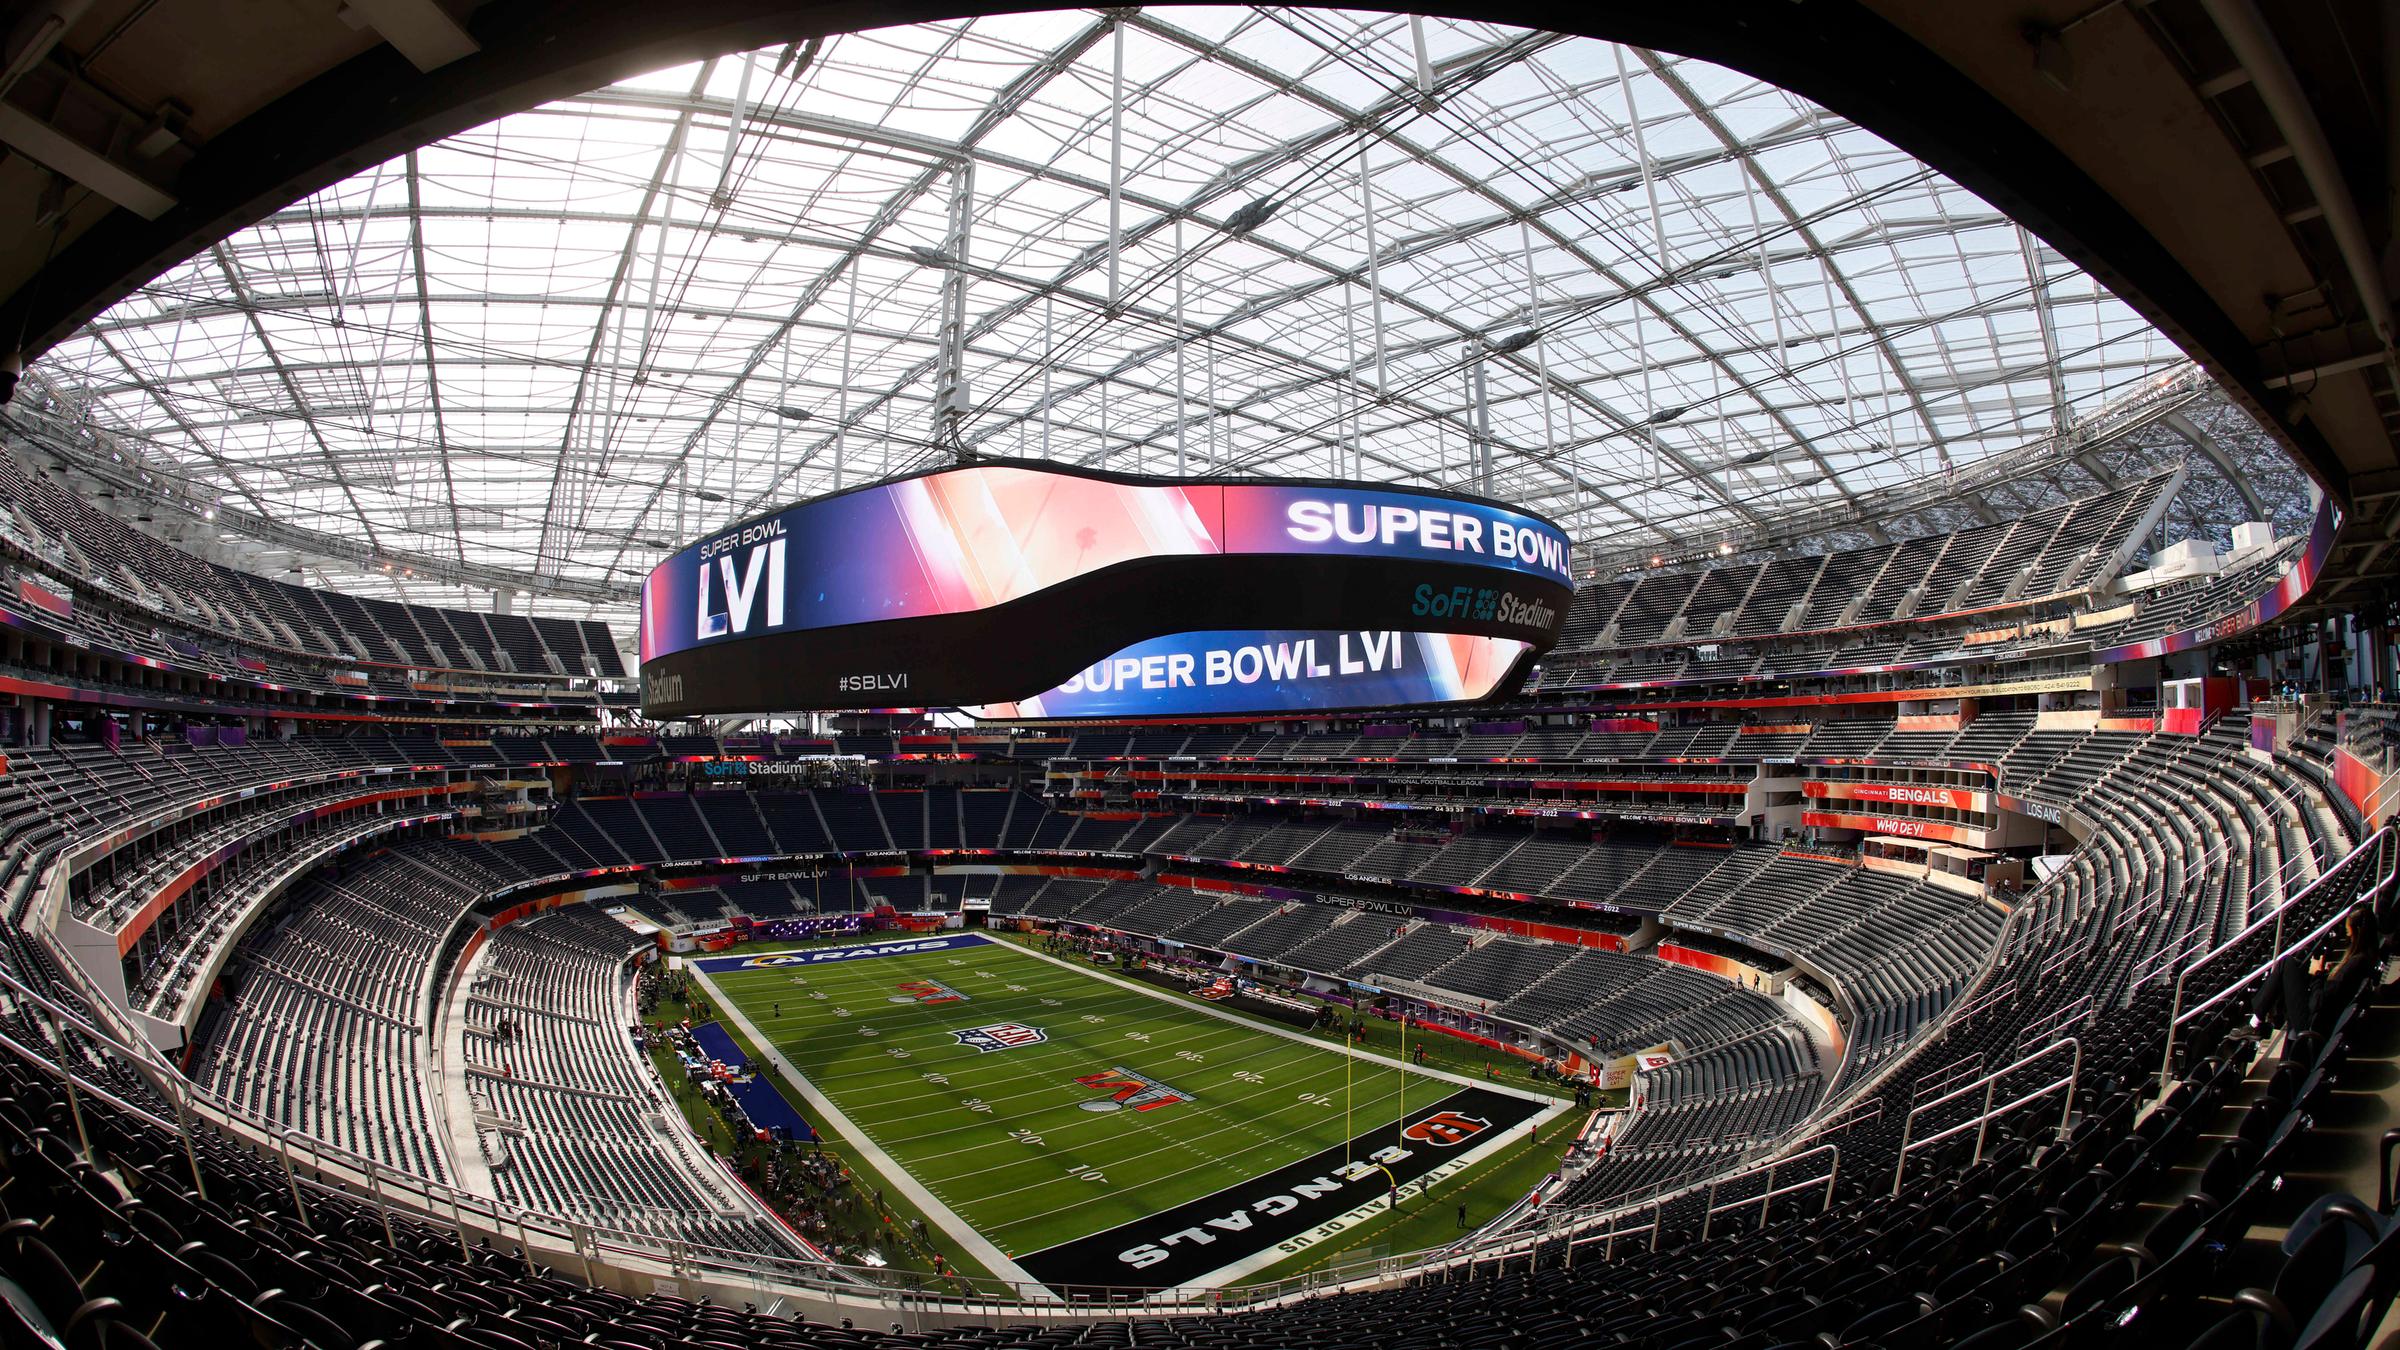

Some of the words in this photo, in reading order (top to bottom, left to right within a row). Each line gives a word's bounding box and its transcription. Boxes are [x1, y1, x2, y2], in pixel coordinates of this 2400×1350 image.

[700, 534, 740, 561] SUPER
[743, 519, 787, 546] BOWL
[1287, 500, 1485, 554] SUPER
[1493, 520, 1567, 576] BOWL
[697, 538, 787, 641] LVI
[1412, 583, 1472, 619] SoFi
[1496, 592, 1555, 631] Stadium
[1059, 653, 1196, 694] SUPER
[1205, 639, 1331, 685] BOWL
[1339, 630, 1402, 674] LVI
[648, 667, 683, 705] Stadium
[839, 673, 908, 692] #SBLVI
[704, 761, 733, 776] SoFi
[749, 761, 803, 775] Stadium
[1853, 788, 1889, 796] CINCINNATI
[1889, 787, 1949, 805] BENGALS
[1675, 816, 1698, 824] BOWL
[1699, 817, 1712, 825] LVI
[2026, 803, 2043, 819] LOS
[2042, 808, 2060, 824] ANG
[1876, 819, 1898, 833] WHO
[1899, 822, 1924, 838] DEY!
[741, 872, 776, 883] SUPR
[778, 871, 810, 881] BOWL
[1345, 873, 1358, 881] LOS
[1358, 875, 1392, 885] ANGELES
[1315, 894, 1356, 908] SUPER
[1356, 900, 1393, 914] BOWL
[1394, 905, 1412, 916] LVI
[1672, 920, 1689, 929] SUPER
[1689, 923, 1704, 932] BOWL
[812, 940, 950, 962] RAMS
[990, 1025, 1040, 1046] NFL
[921, 1072, 948, 1084] 40
[1232, 1070, 1264, 1084] 20
[961, 1097, 991, 1112] 30
[1298, 1092, 1329, 1105] 10
[1008, 1127, 1042, 1144] 20
[1065, 1164, 1103, 1181] 10
[1446, 1159, 1469, 1171] IT
[1117, 1145, 1414, 1271] BENGALS
[1344, 1200, 1386, 1220] ALL
[1317, 1221, 1346, 1238] OF
[1277, 1236, 1313, 1254] US
